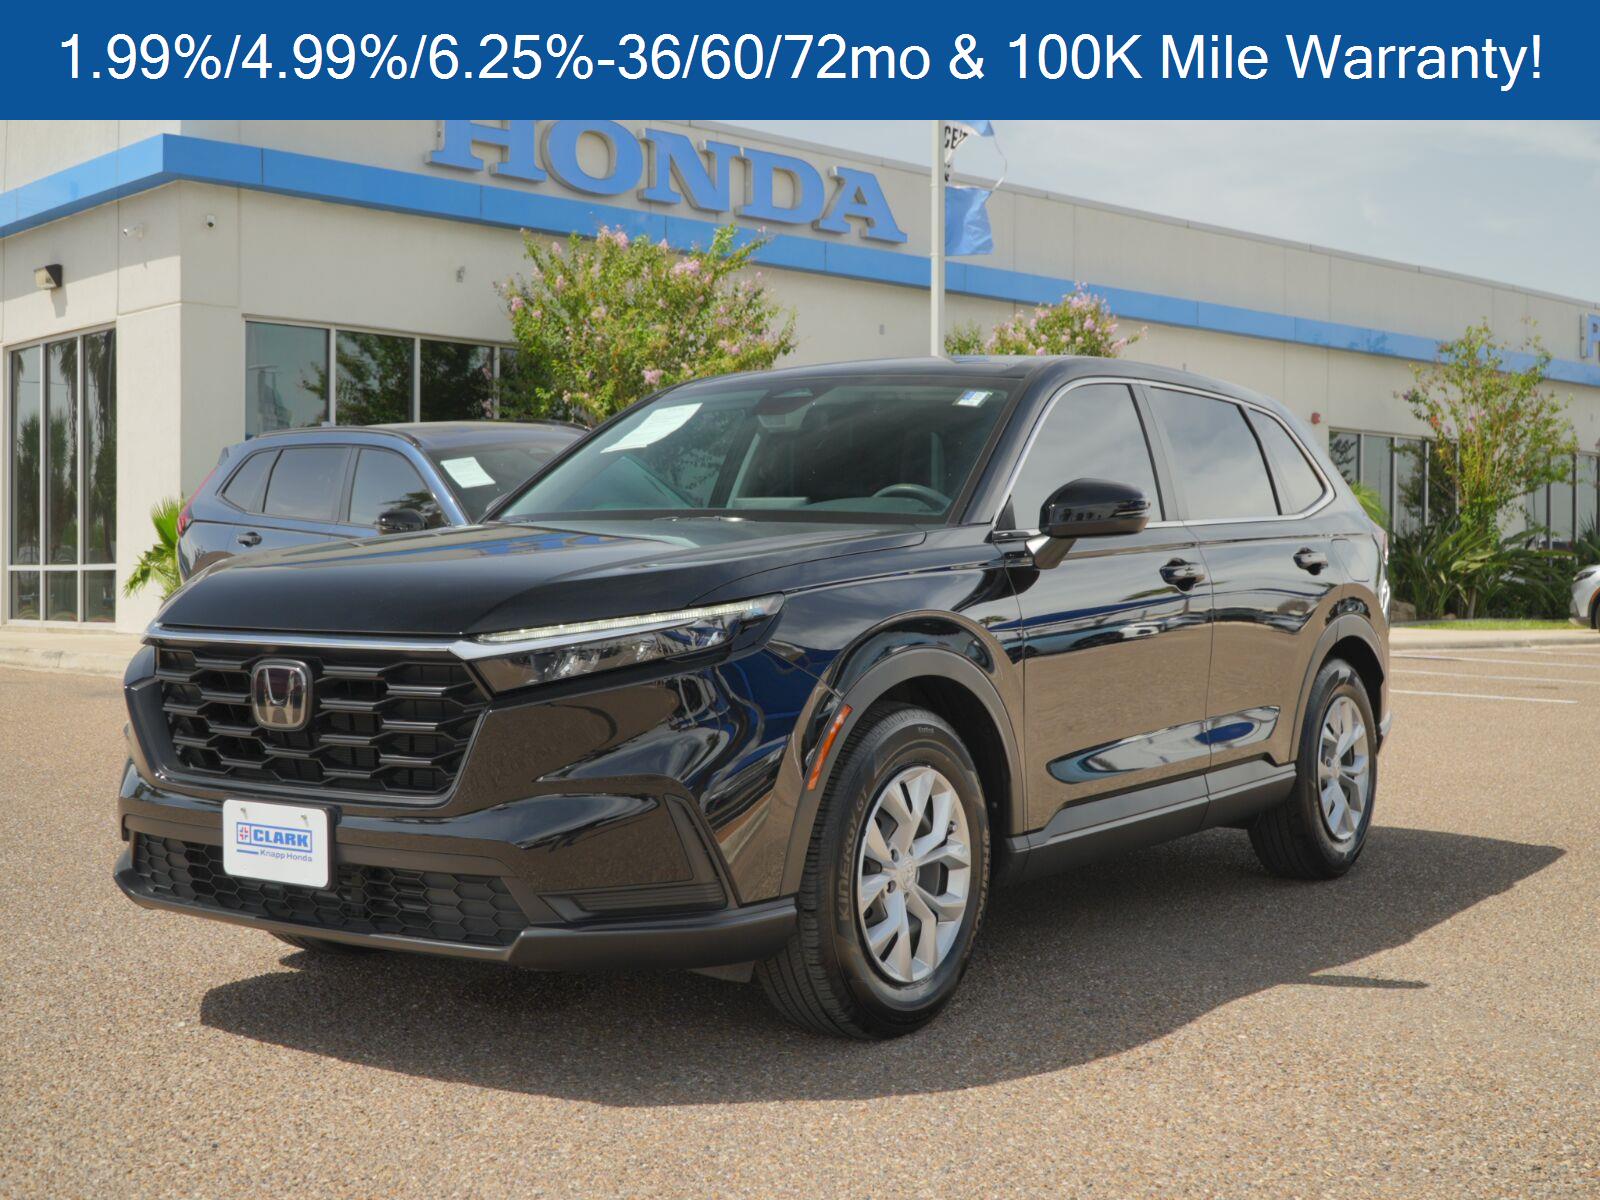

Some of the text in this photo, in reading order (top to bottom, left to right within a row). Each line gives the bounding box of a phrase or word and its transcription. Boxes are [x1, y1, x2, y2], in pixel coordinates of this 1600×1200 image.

[425, 120, 908, 244] HONDA
[253, 828, 309, 848] CLARK
[260, 849, 313, 862] Knapp Honda
